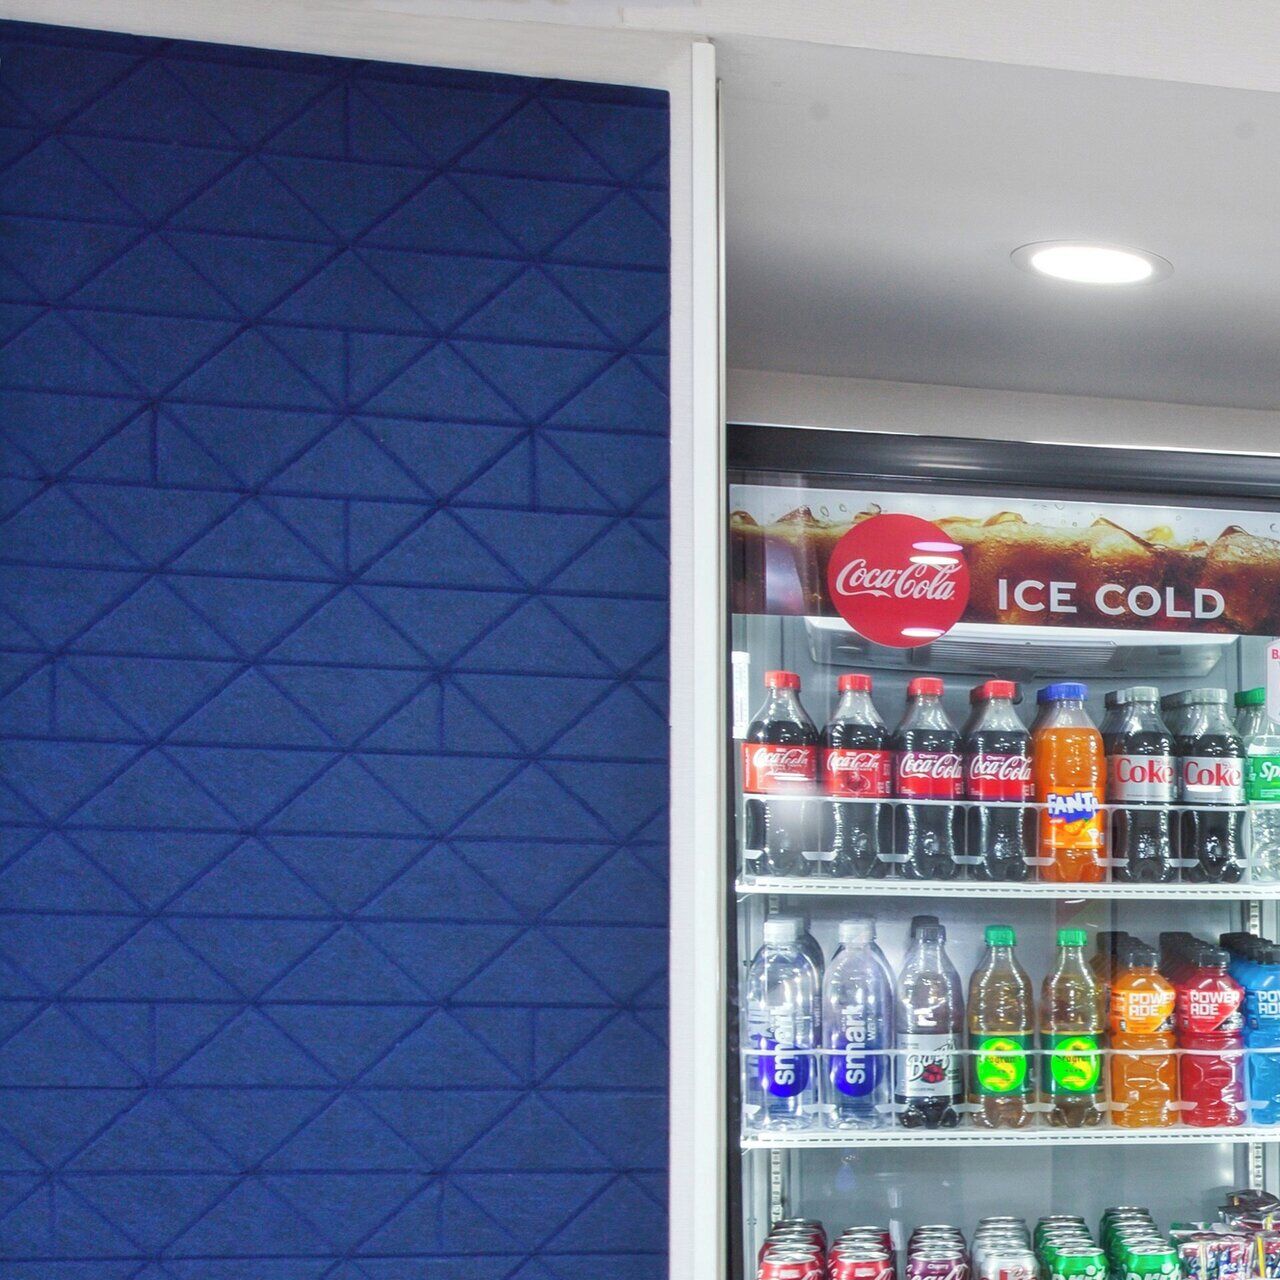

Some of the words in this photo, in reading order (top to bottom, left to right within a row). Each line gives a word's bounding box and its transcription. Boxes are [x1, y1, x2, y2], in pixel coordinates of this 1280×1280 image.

[836, 558, 956, 603] Coca-Cola
[998, 577, 1077, 614] ICE
[1094, 583, 1226, 620] COLD
[900, 752, 963, 780] Coca-Cola
[970, 755, 1034, 782] Coca-Cola
[1115, 757, 1175, 785] Coke
[1182, 760, 1241, 787] Coke
[1128, 992, 1176, 1006] POWER
[1128, 1003, 1160, 1017] ADE
[1189, 990, 1240, 1005] POWER
[1190, 1003, 1220, 1017] ADE
[842, 1005, 866, 1085] smart
